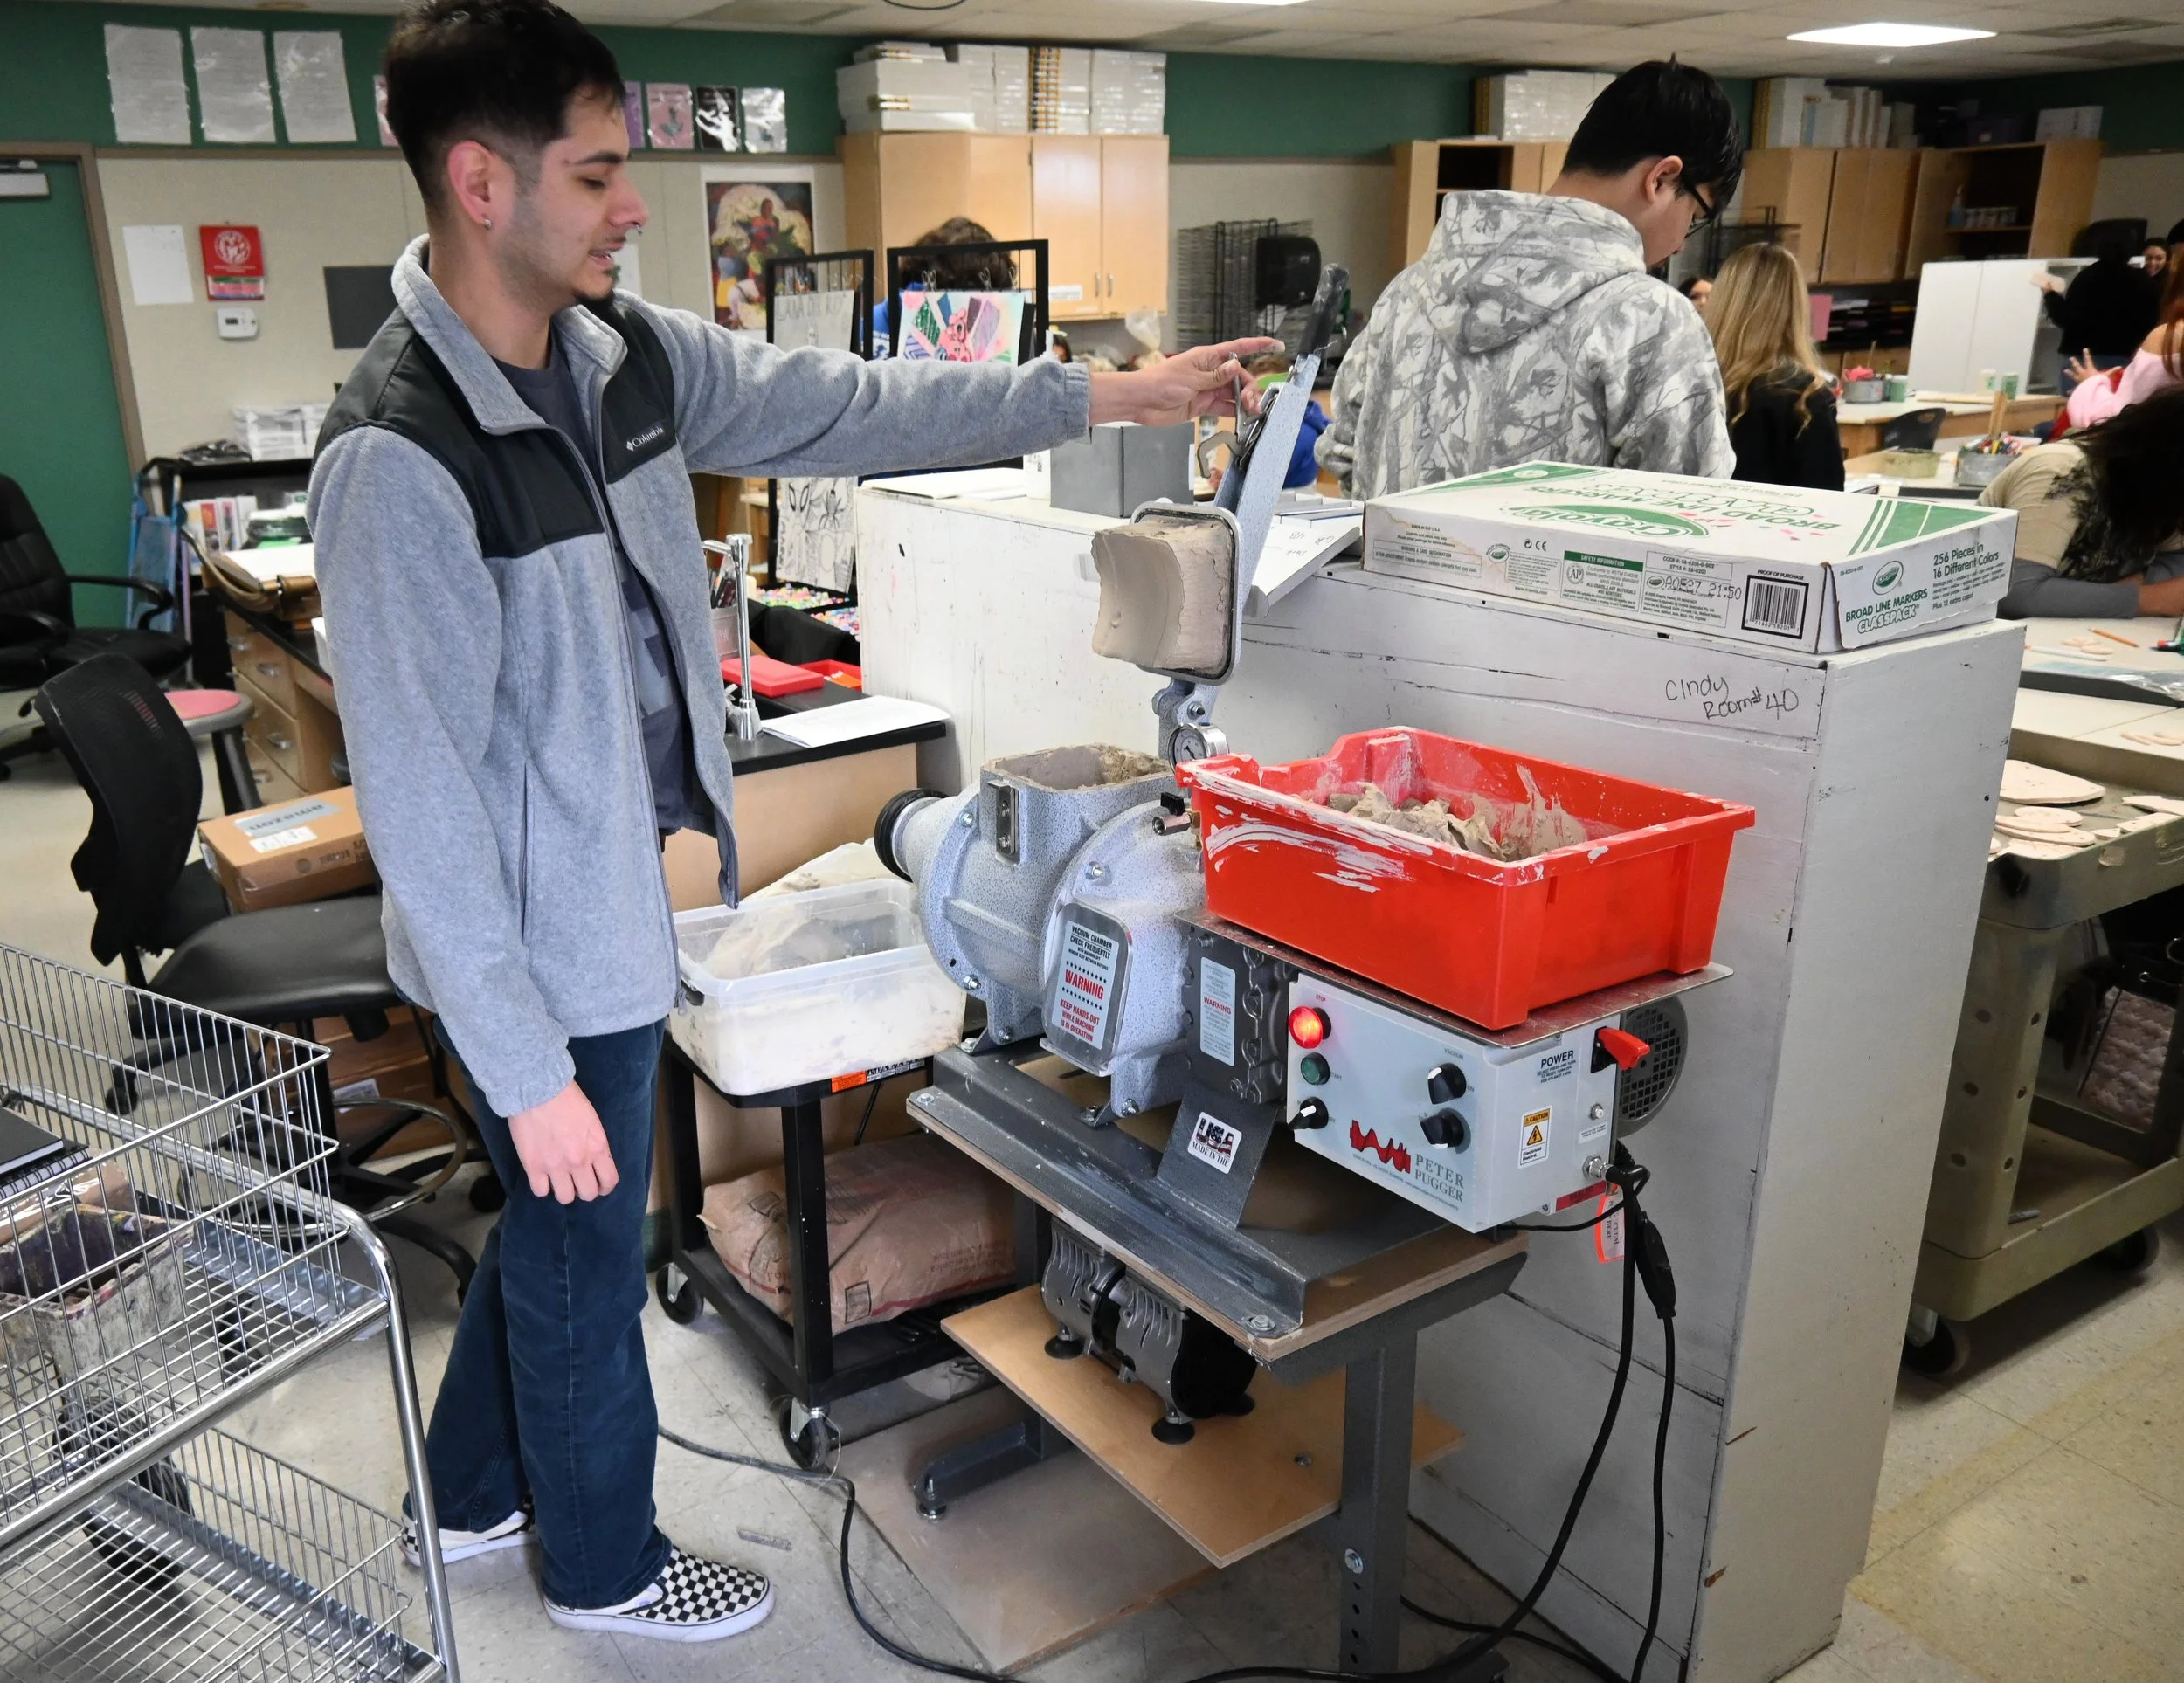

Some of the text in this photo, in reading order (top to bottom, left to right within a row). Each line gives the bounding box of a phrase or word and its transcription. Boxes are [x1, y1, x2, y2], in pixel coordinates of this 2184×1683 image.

[632, 426, 664, 448] Columbia
[1524, 486, 1651, 503] MARKERS
[1650, 500, 1718, 514] LINE
[1511, 507, 1683, 537] Crayola
[1721, 510, 1842, 530] BROAD
[1933, 542, 1984, 566] 256 Pieces in
[1780, 572, 1804, 581] PURCHASE
[1933, 569, 1942, 579] 16
[1944, 557, 1977, 576] Different
[1978, 552, 2000, 567] Colors
[1708, 583, 1742, 600] 21:50
[1845, 604, 1873, 622] BROAD
[1875, 599, 1891, 613] LINE
[1892, 588, 1928, 609] MARKERS
[1766, 688, 1800, 721] 40
[1069, 935, 1110, 960] CHECK FREQUENTLY
[1071, 925, 1113, 950] VACUUM CHAMBER
[1065, 968, 1104, 1000] WARNING
[1204, 997, 1232, 1015] WARNING
[1316, 994, 1326, 1003] STOP
[1060, 998, 1100, 1025] KEEP HANDS OUT
[1062, 1011, 1095, 1032] WHILE MACHINE
[1070, 1025, 1093, 1042] OPERATION
[1540, 1050, 1574, 1069] POWER
[1468, 1084, 1475, 1093] ON
[1529, 1111, 1548, 1122] CAUTION
[1196, 1117, 1234, 1156] USA
[1192, 1141, 1229, 1168] MADE IN THE
[1523, 1147, 1542, 1156] Electrical
[1415, 1153, 1465, 1190] PETER
[1415, 1169, 1463, 1203] PUGGER
